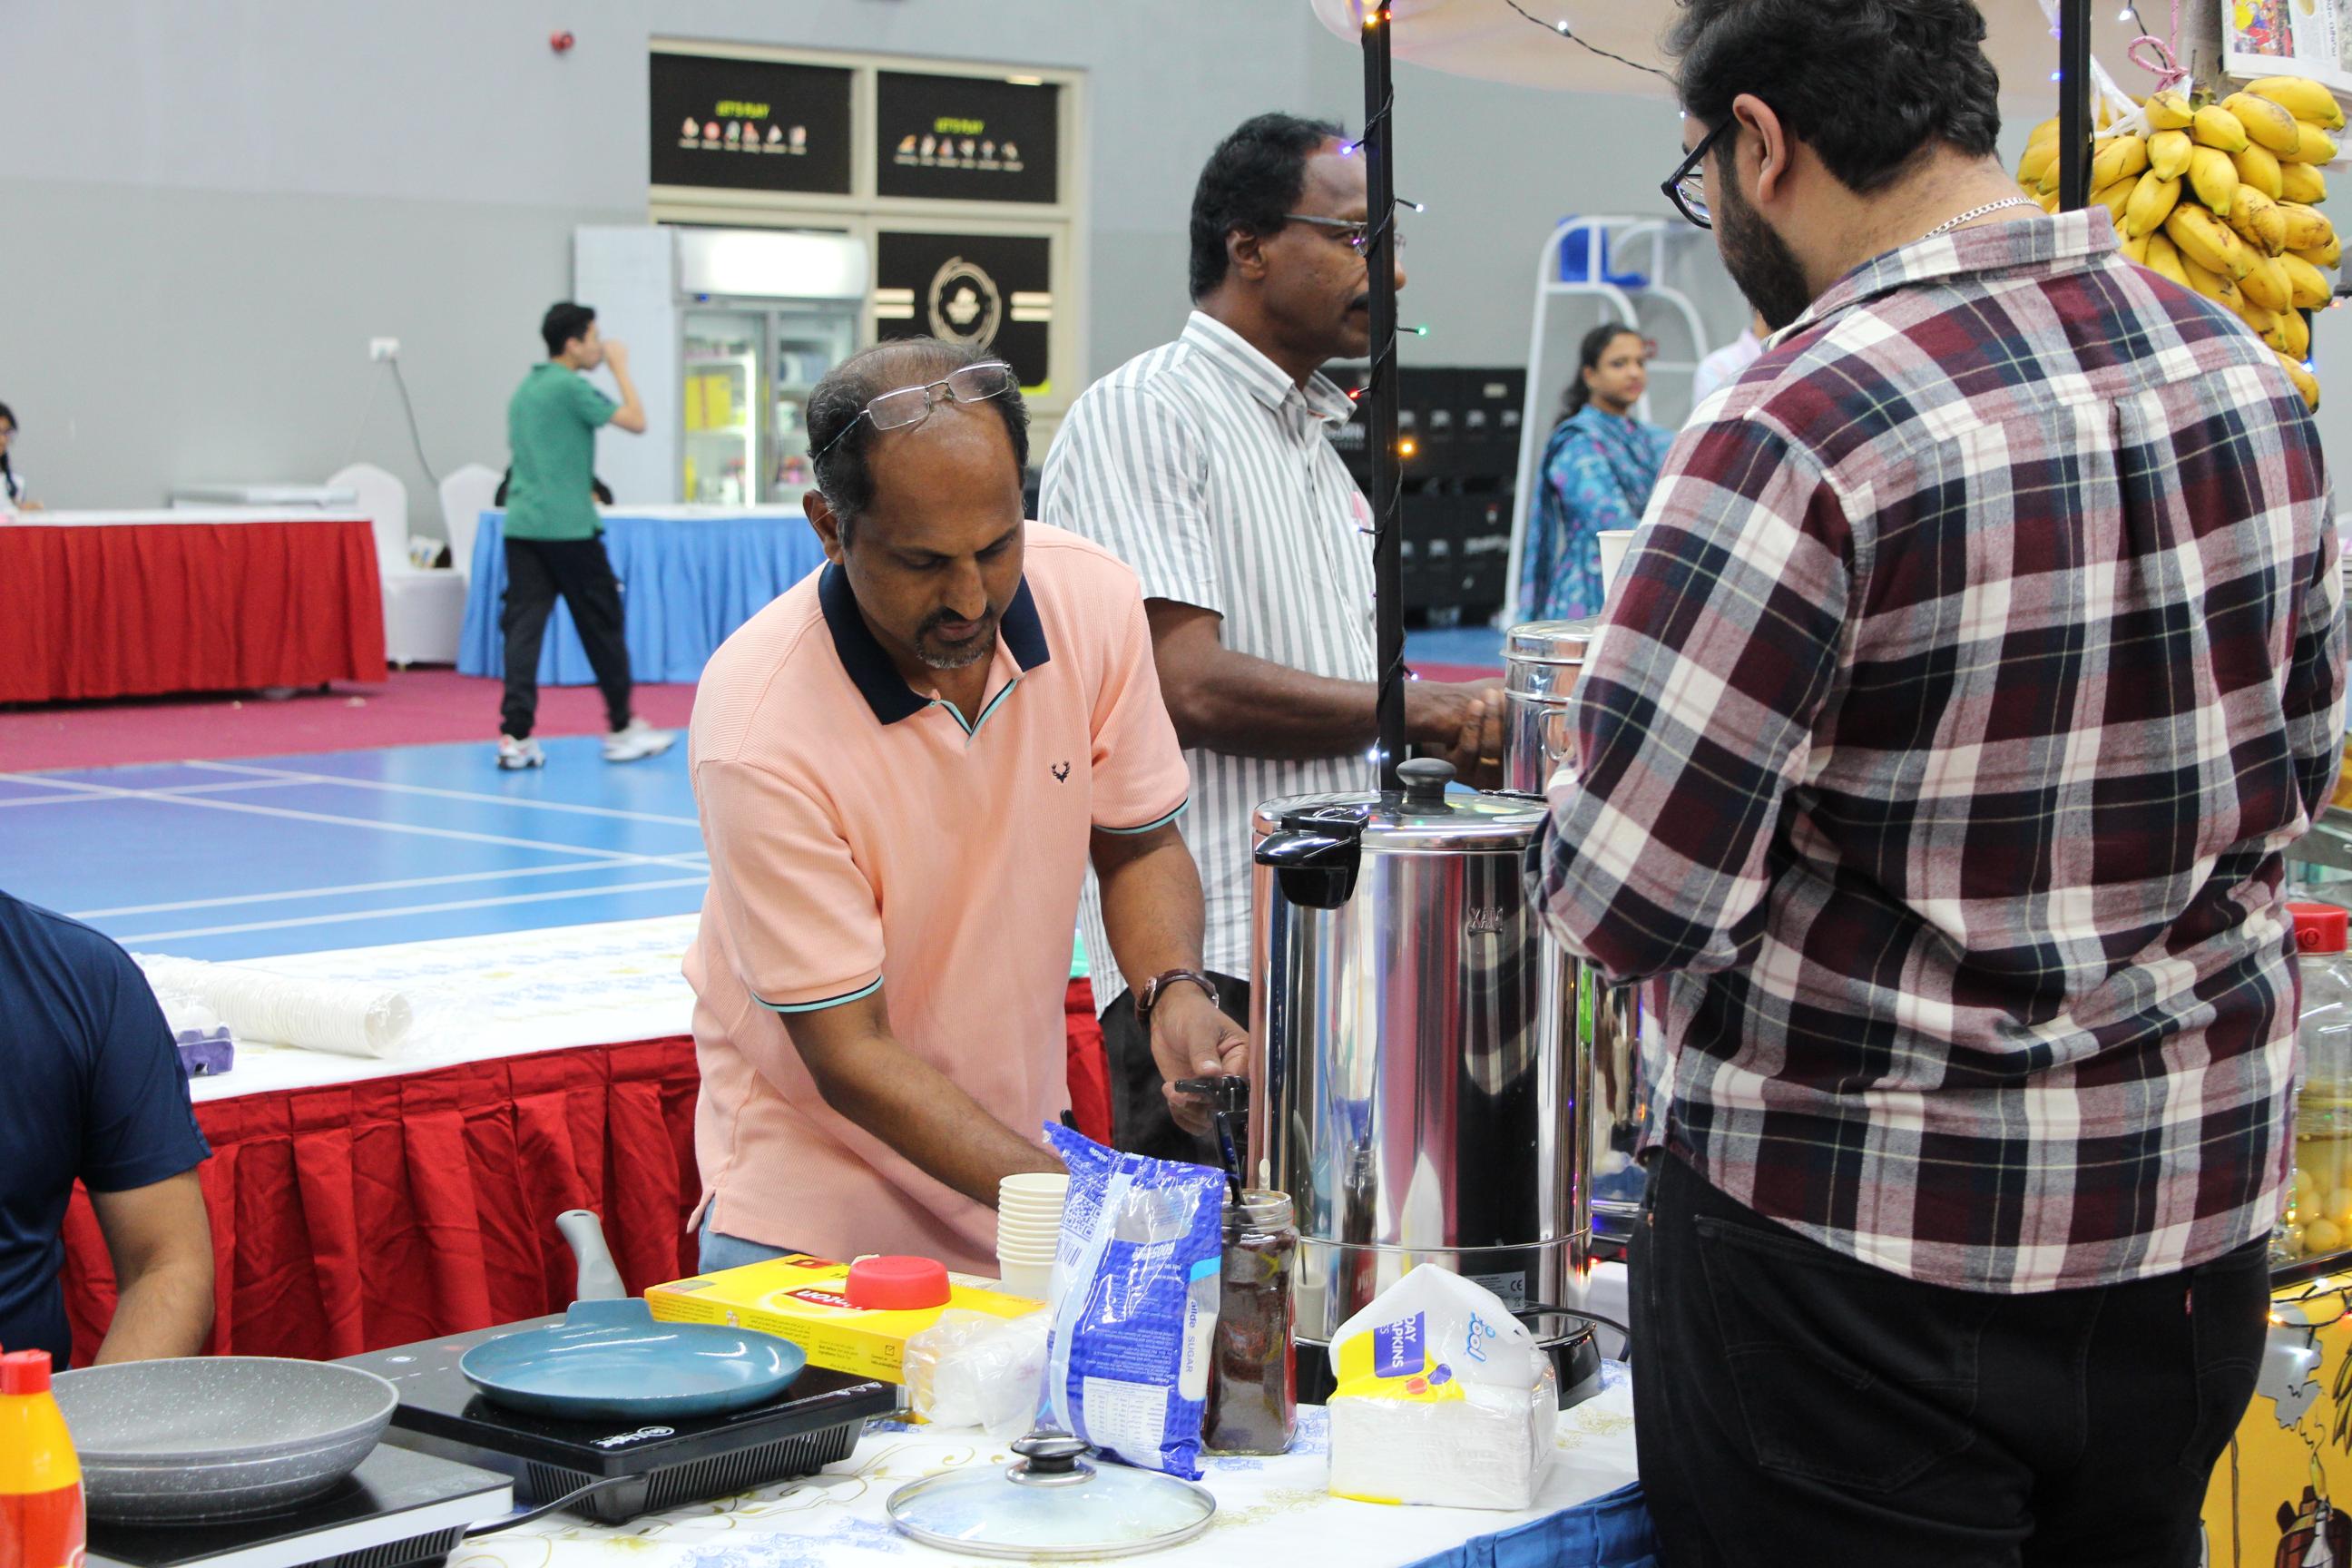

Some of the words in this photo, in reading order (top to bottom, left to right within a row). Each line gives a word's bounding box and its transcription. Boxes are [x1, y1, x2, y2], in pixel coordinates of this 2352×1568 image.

[1185, 1335, 1196, 1373] SUGAR
[1391, 1320, 1403, 1368] APKINS
[1467, 1311, 1486, 1362] ool
